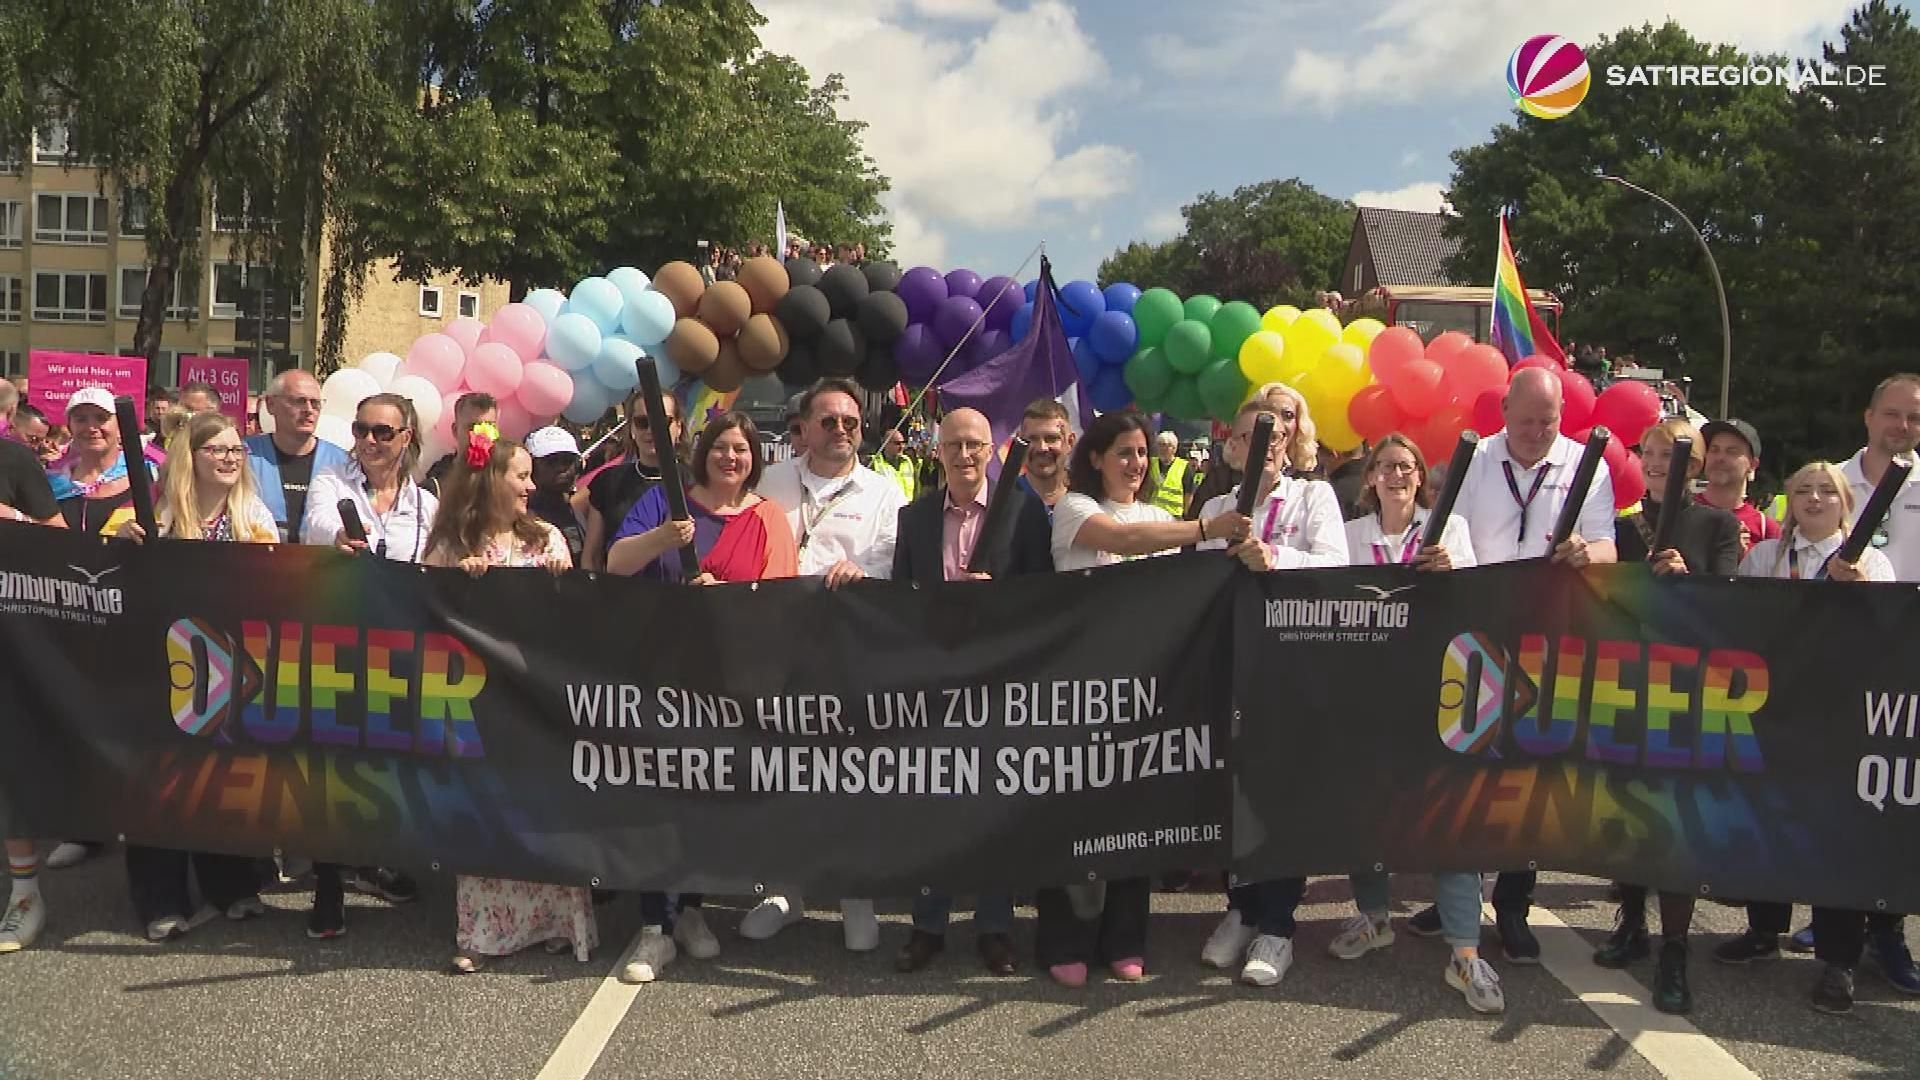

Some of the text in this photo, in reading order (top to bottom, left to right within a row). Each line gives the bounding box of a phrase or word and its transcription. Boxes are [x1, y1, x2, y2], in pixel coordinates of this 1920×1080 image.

[47, 364, 66, 374] Wir
[68, 365, 89, 375] sind
[115, 369, 132, 378] um
[221, 370, 240, 387] GG
[0, 570, 124, 614] amburgpride
[1265, 599, 1409, 628] hamburgpride
[1279, 632, 1390, 642] CHRISTOPHER STREET DAY
[166, 617, 488, 758] QUEER
[566, 676, 1164, 736] WIR SIND HIER, UM ZU BLEIBEN.
[1437, 632, 1770, 774] QUEER
[1865, 690, 1920, 738] WI
[571, 724, 1225, 796] QUEERE MENSCHEN SCHÜTZEN.
[1857, 754, 1920, 812] QU
[1072, 824, 1223, 857] HAMBURG-PRIDE.DE
